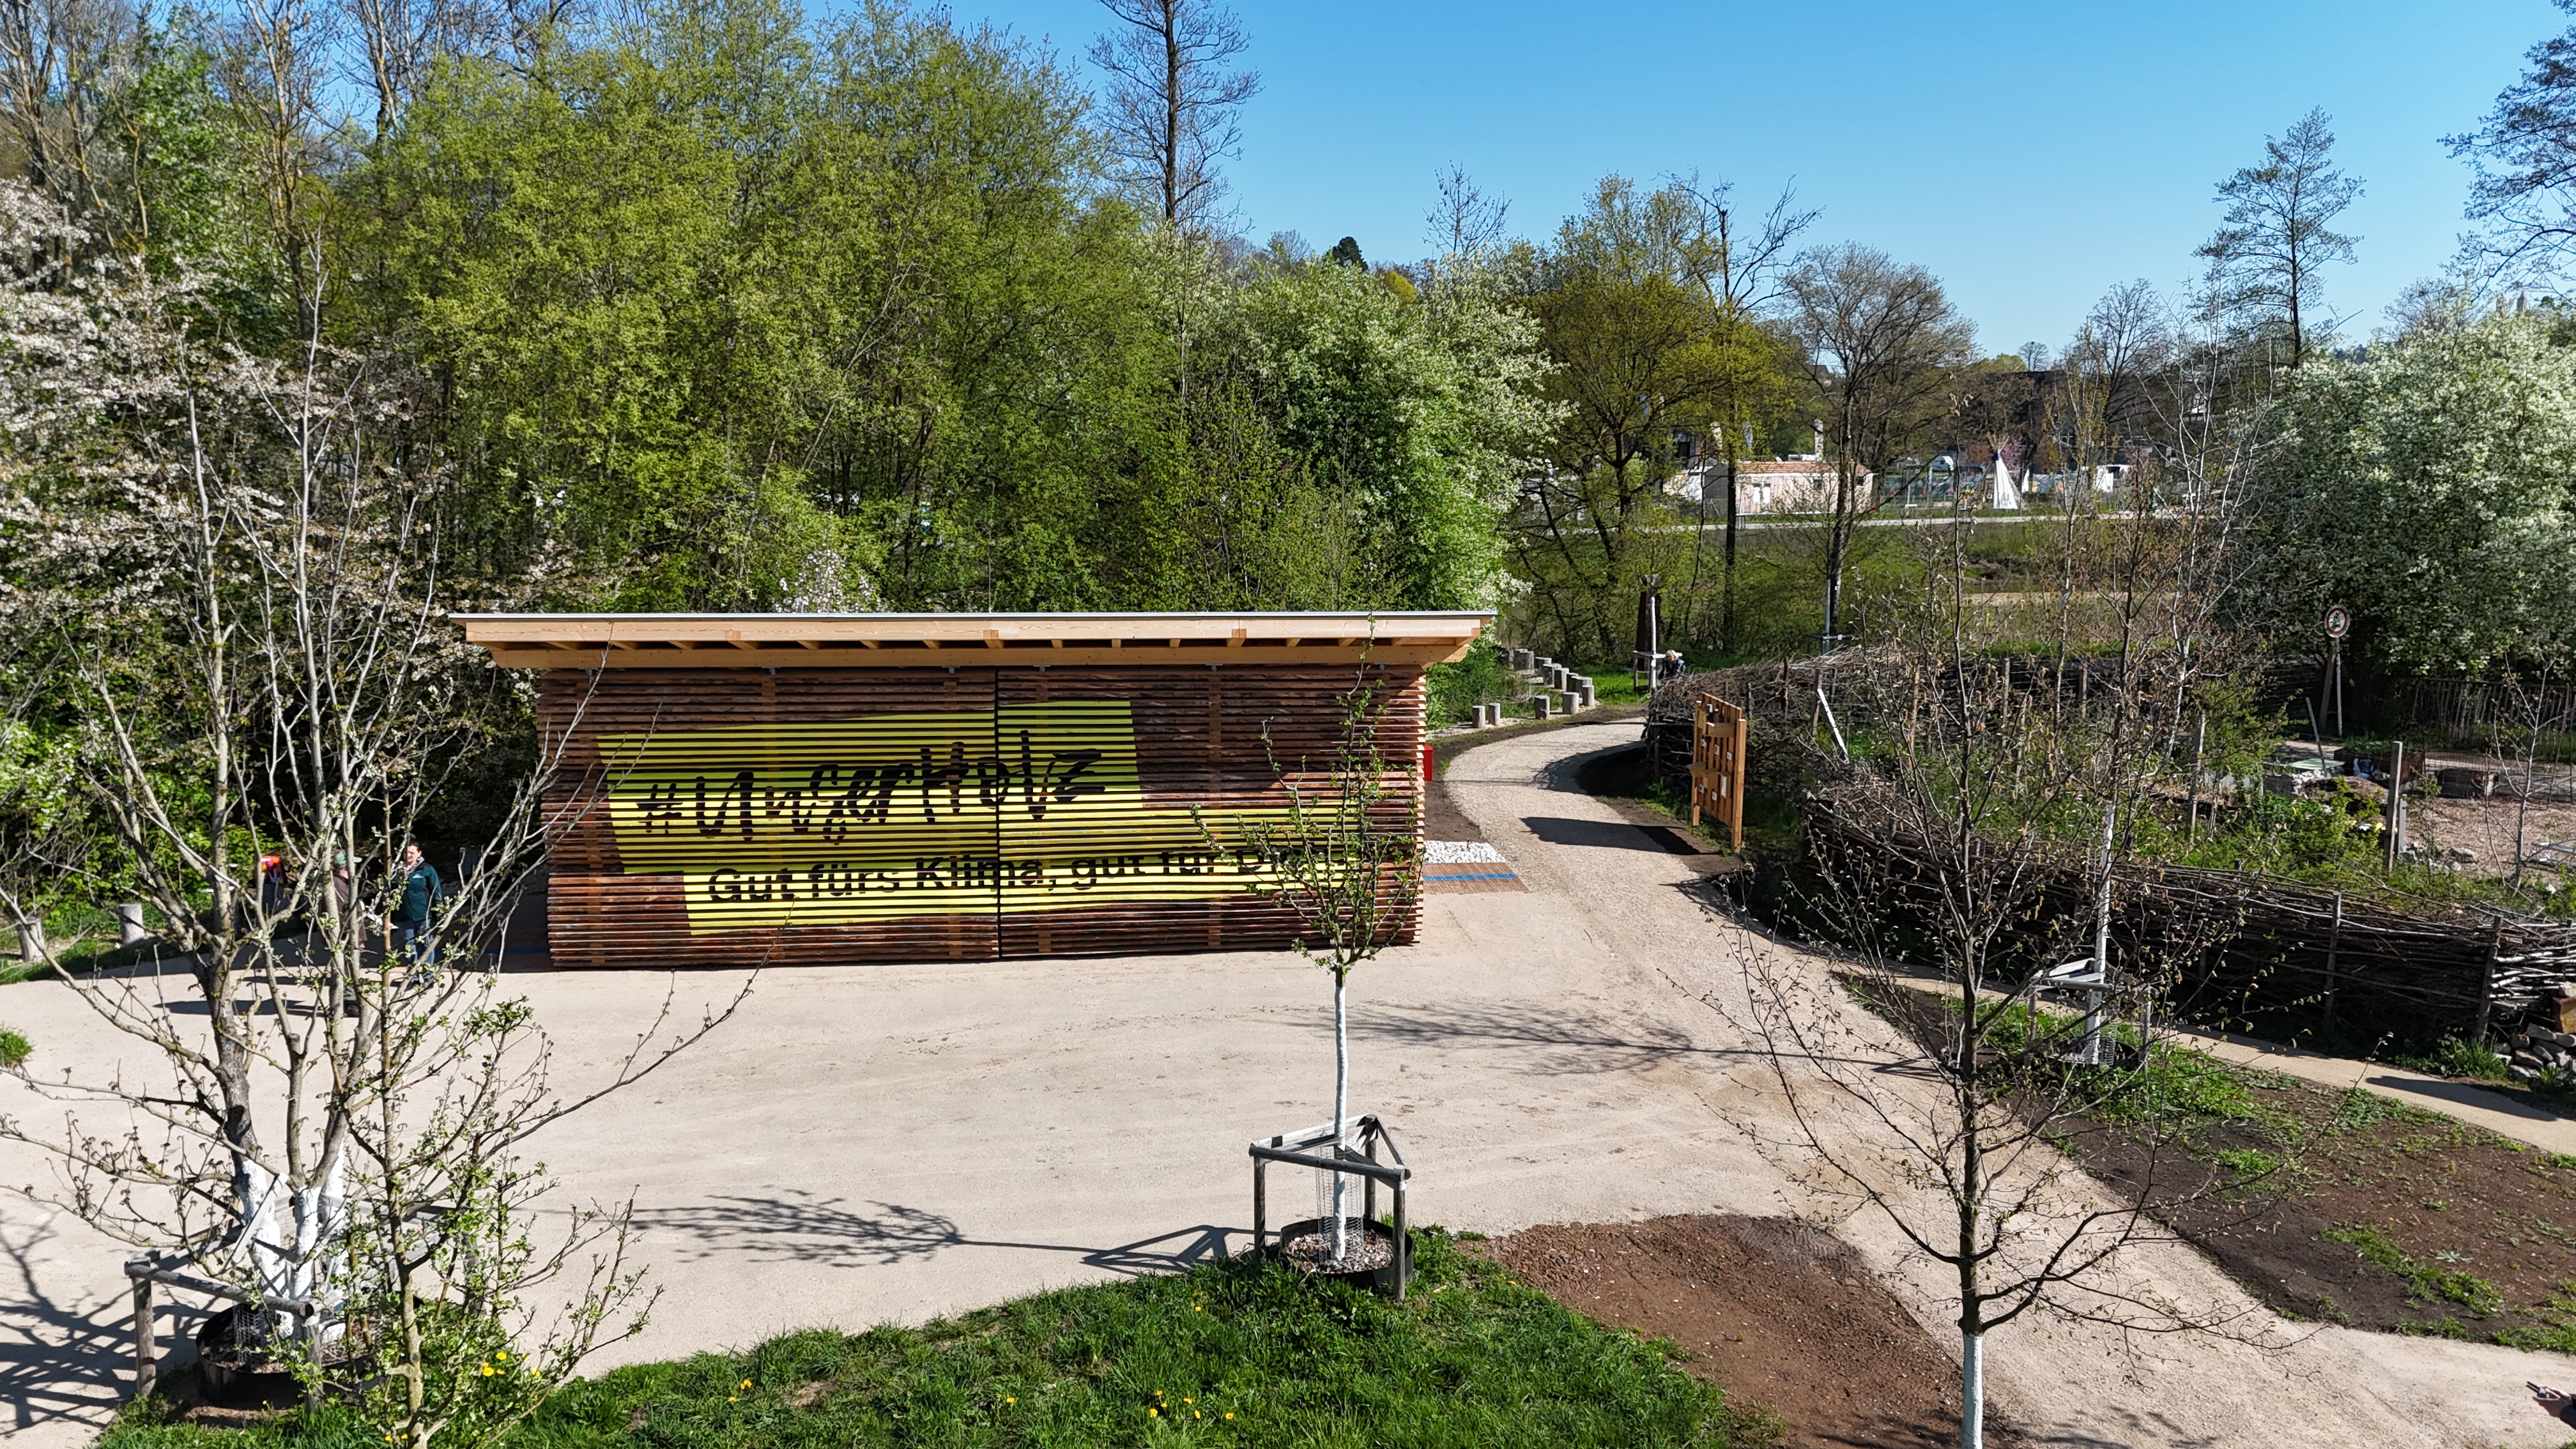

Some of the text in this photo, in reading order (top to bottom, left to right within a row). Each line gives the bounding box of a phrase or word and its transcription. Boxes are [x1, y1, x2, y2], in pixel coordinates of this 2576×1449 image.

[709, 868, 794, 900] Gut
[808, 863, 900, 897] fürs
[916, 853, 1057, 891] Klima,
[1071, 857, 1146, 891] gut
